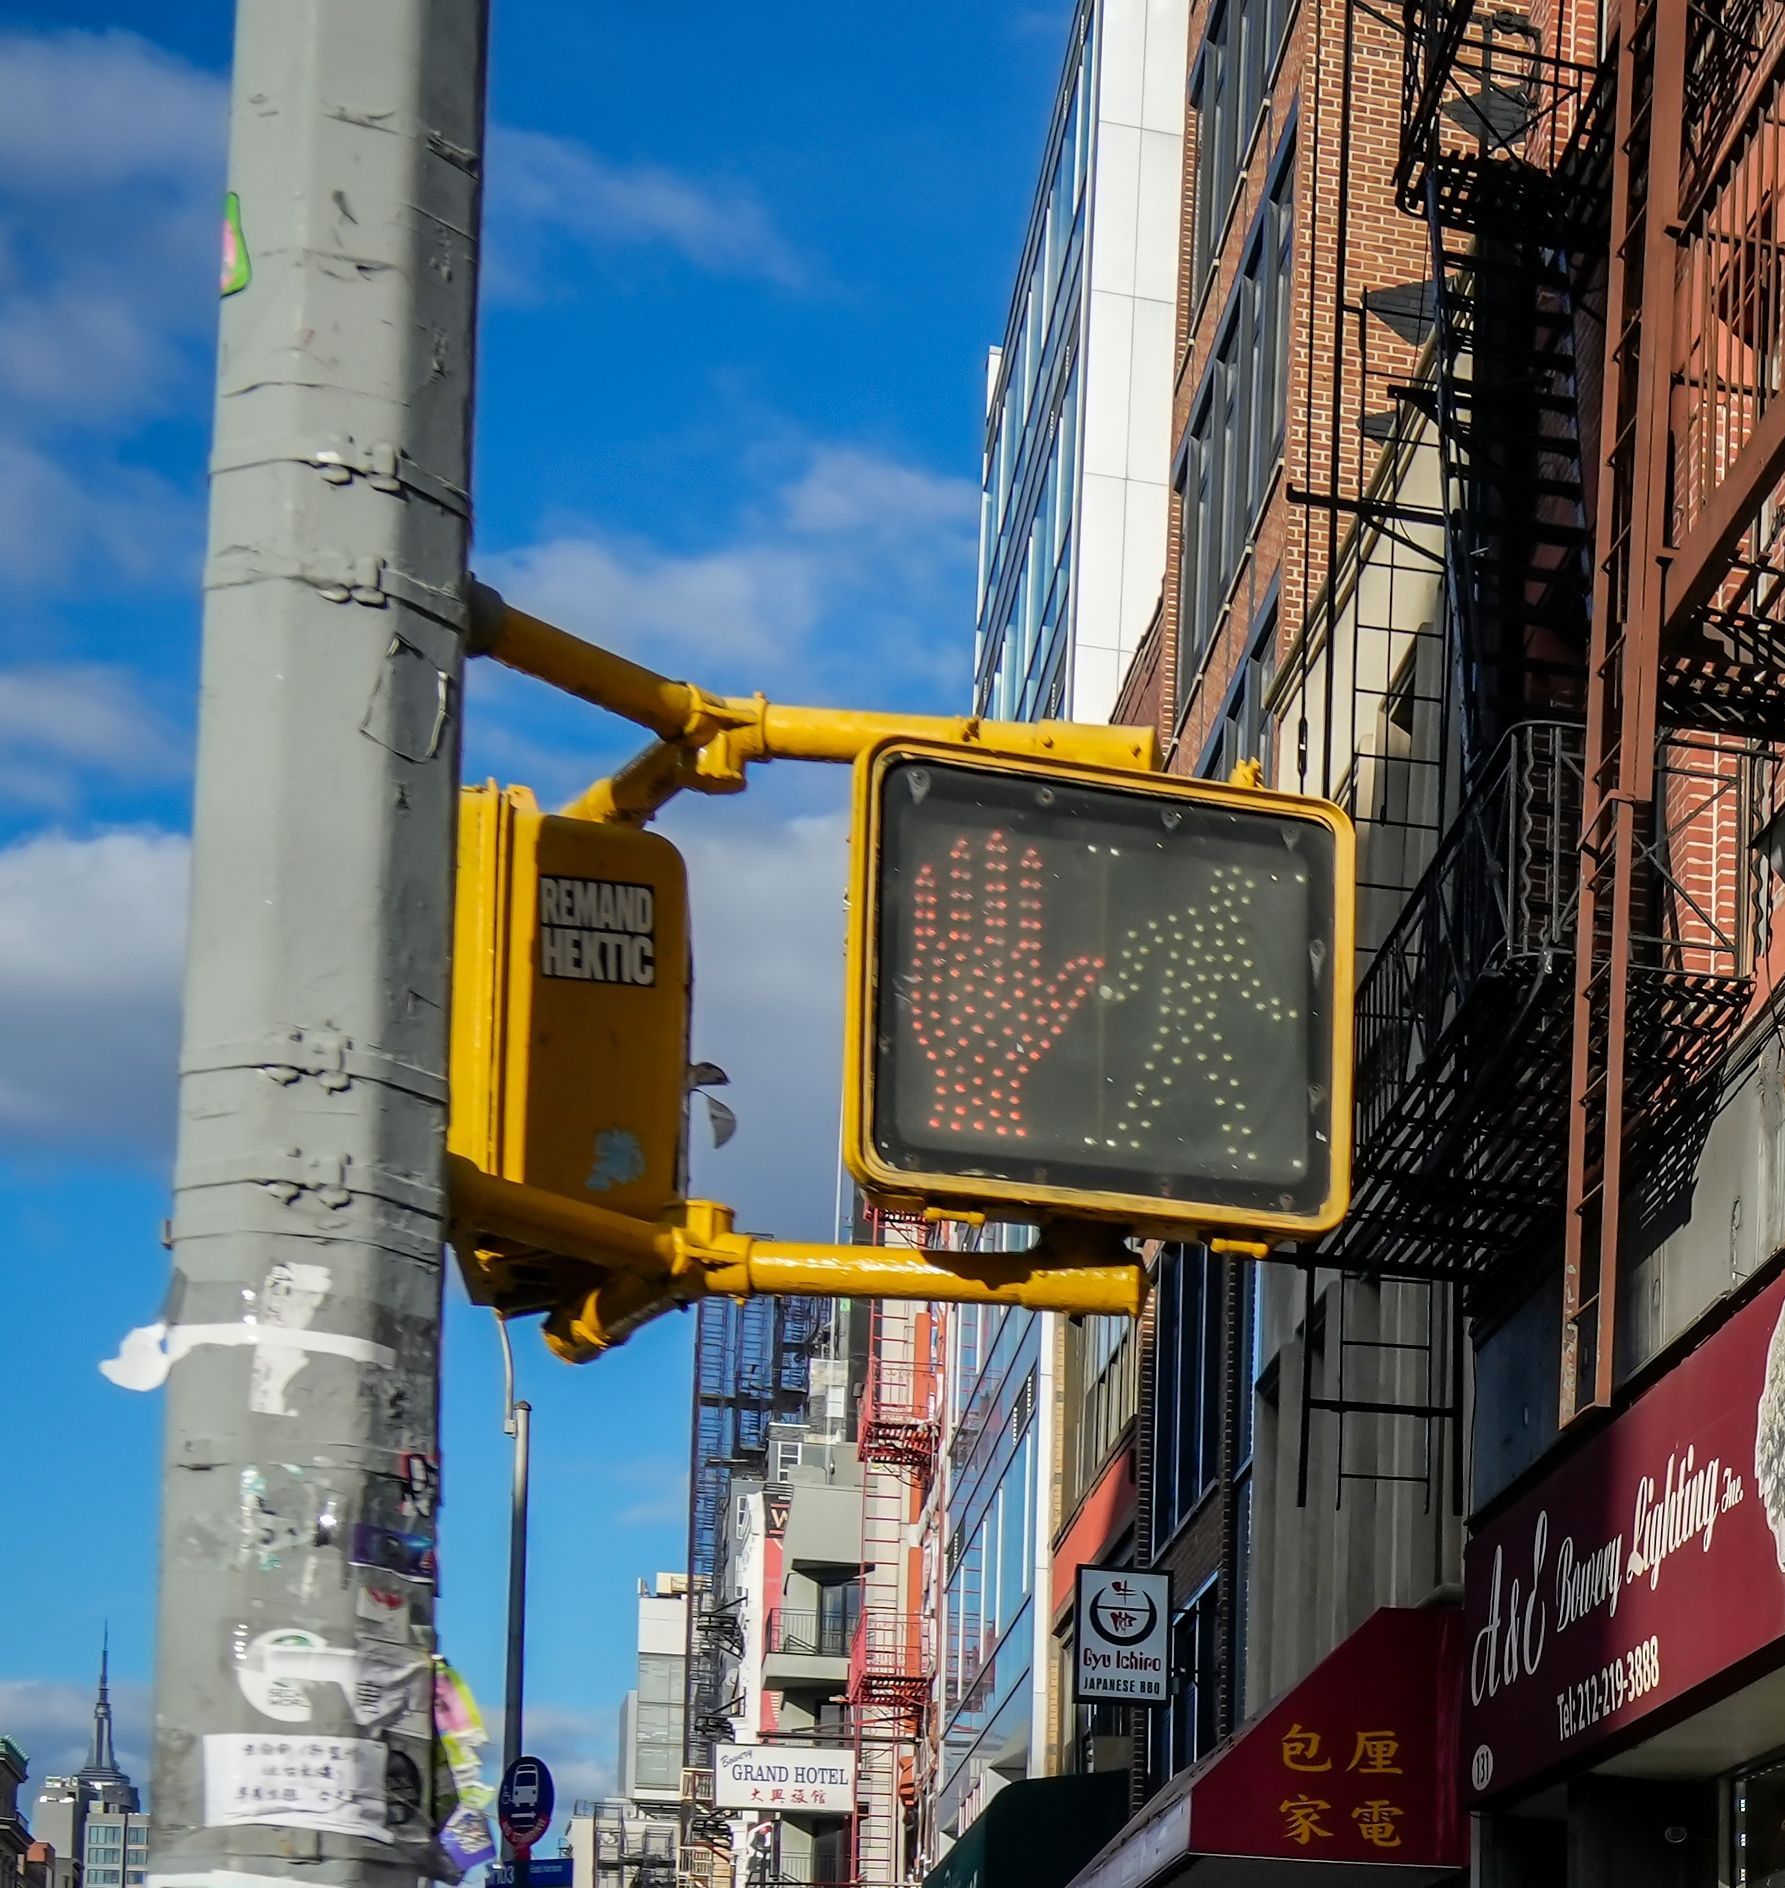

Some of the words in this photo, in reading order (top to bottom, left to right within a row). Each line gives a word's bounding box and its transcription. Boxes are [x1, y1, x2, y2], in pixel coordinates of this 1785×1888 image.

[540, 876, 653, 934] REMAND
[1556, 1534, 1622, 1632] Bowery
[1626, 1444, 1720, 1590] Lighting
[1721, 1467, 1744, 1513] Inc.
[1083, 1647, 1111, 1671] Gyu
[1116, 1650, 1161, 1672] Ichiro
[1084, 1677, 1135, 1693] JAPANESE
[1140, 1681, 1160, 1695] BBQ
[1557, 1685, 1577, 1741] Tel:
[1578, 1635, 1659, 1732] 212-219-3888
[732, 1764, 789, 1783] GRAND
[794, 1767, 849, 1785] HOTEL
[1474, 1749, 1491, 1786] 131
